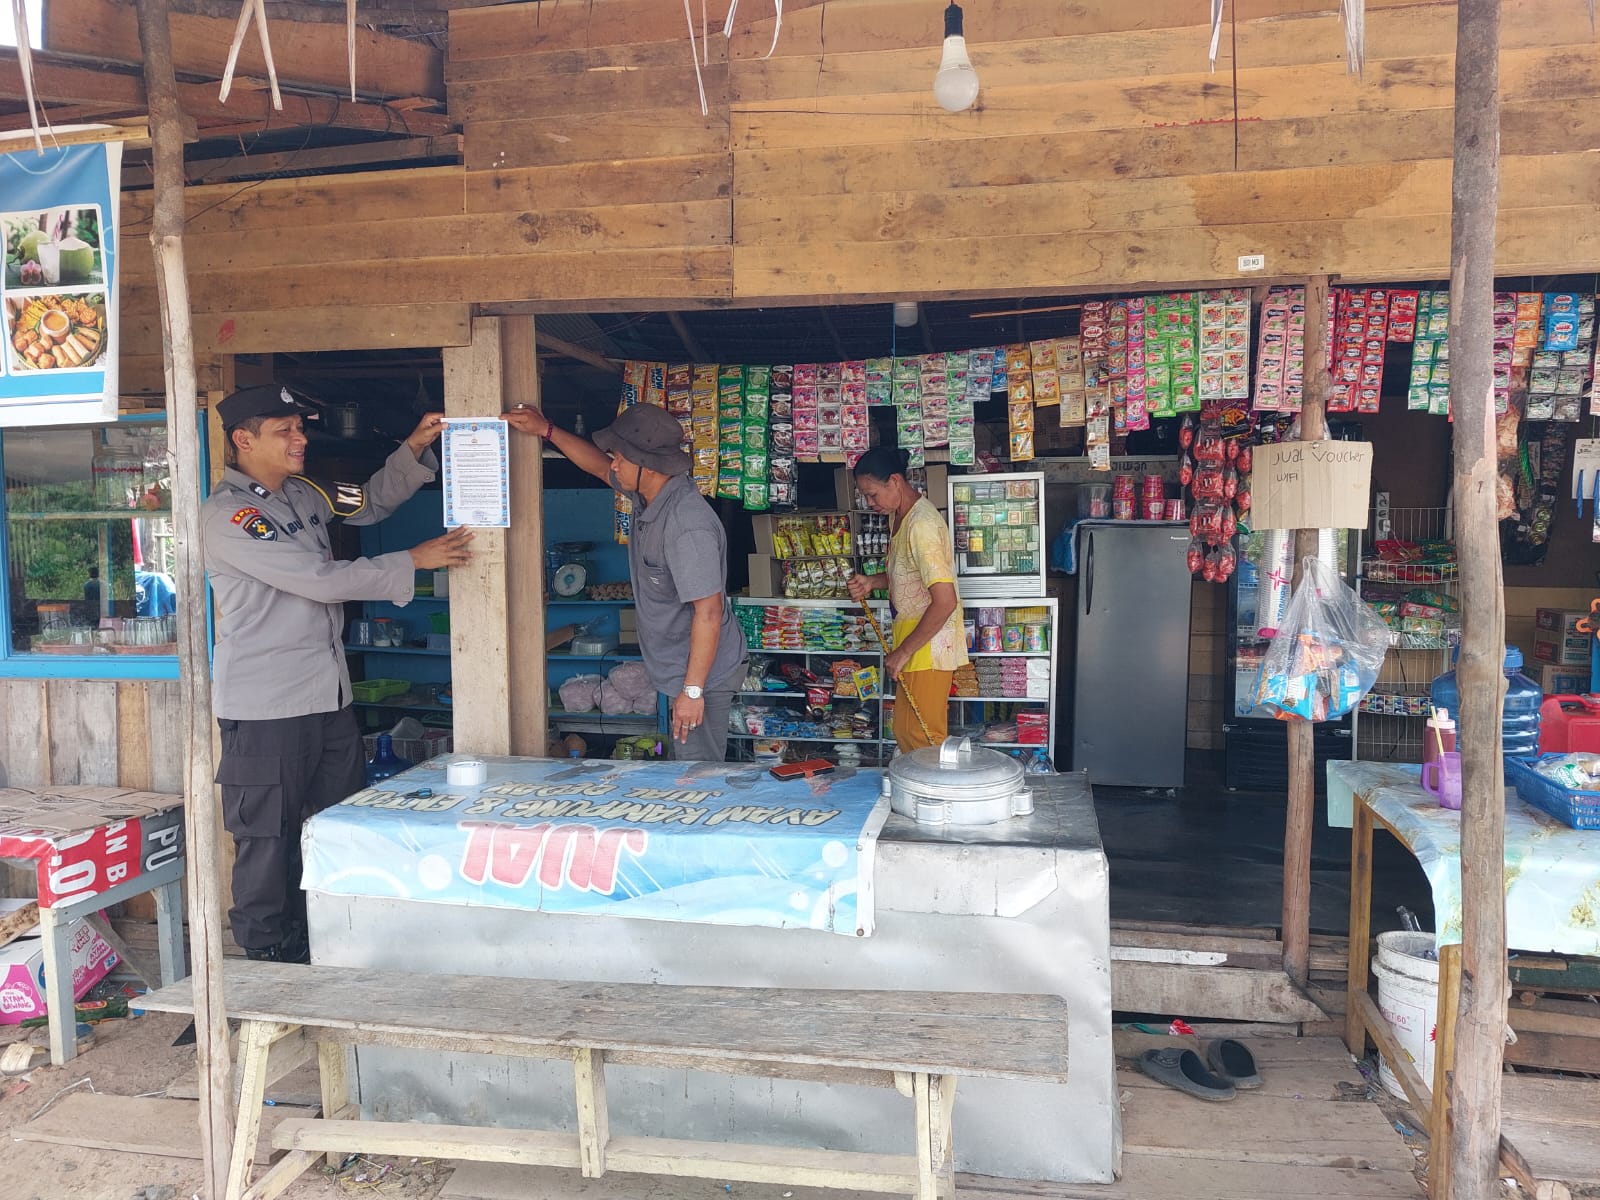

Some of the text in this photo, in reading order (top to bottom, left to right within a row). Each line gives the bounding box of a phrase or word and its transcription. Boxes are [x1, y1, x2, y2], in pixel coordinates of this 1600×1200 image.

[463, 797, 506, 816] &
[501, 799, 709, 826] KAMPUNG
[703, 806, 842, 827] AYAM
[145, 823, 185, 872] PU
[460, 820, 648, 895] JUAL
[106, 861, 127, 888] B
